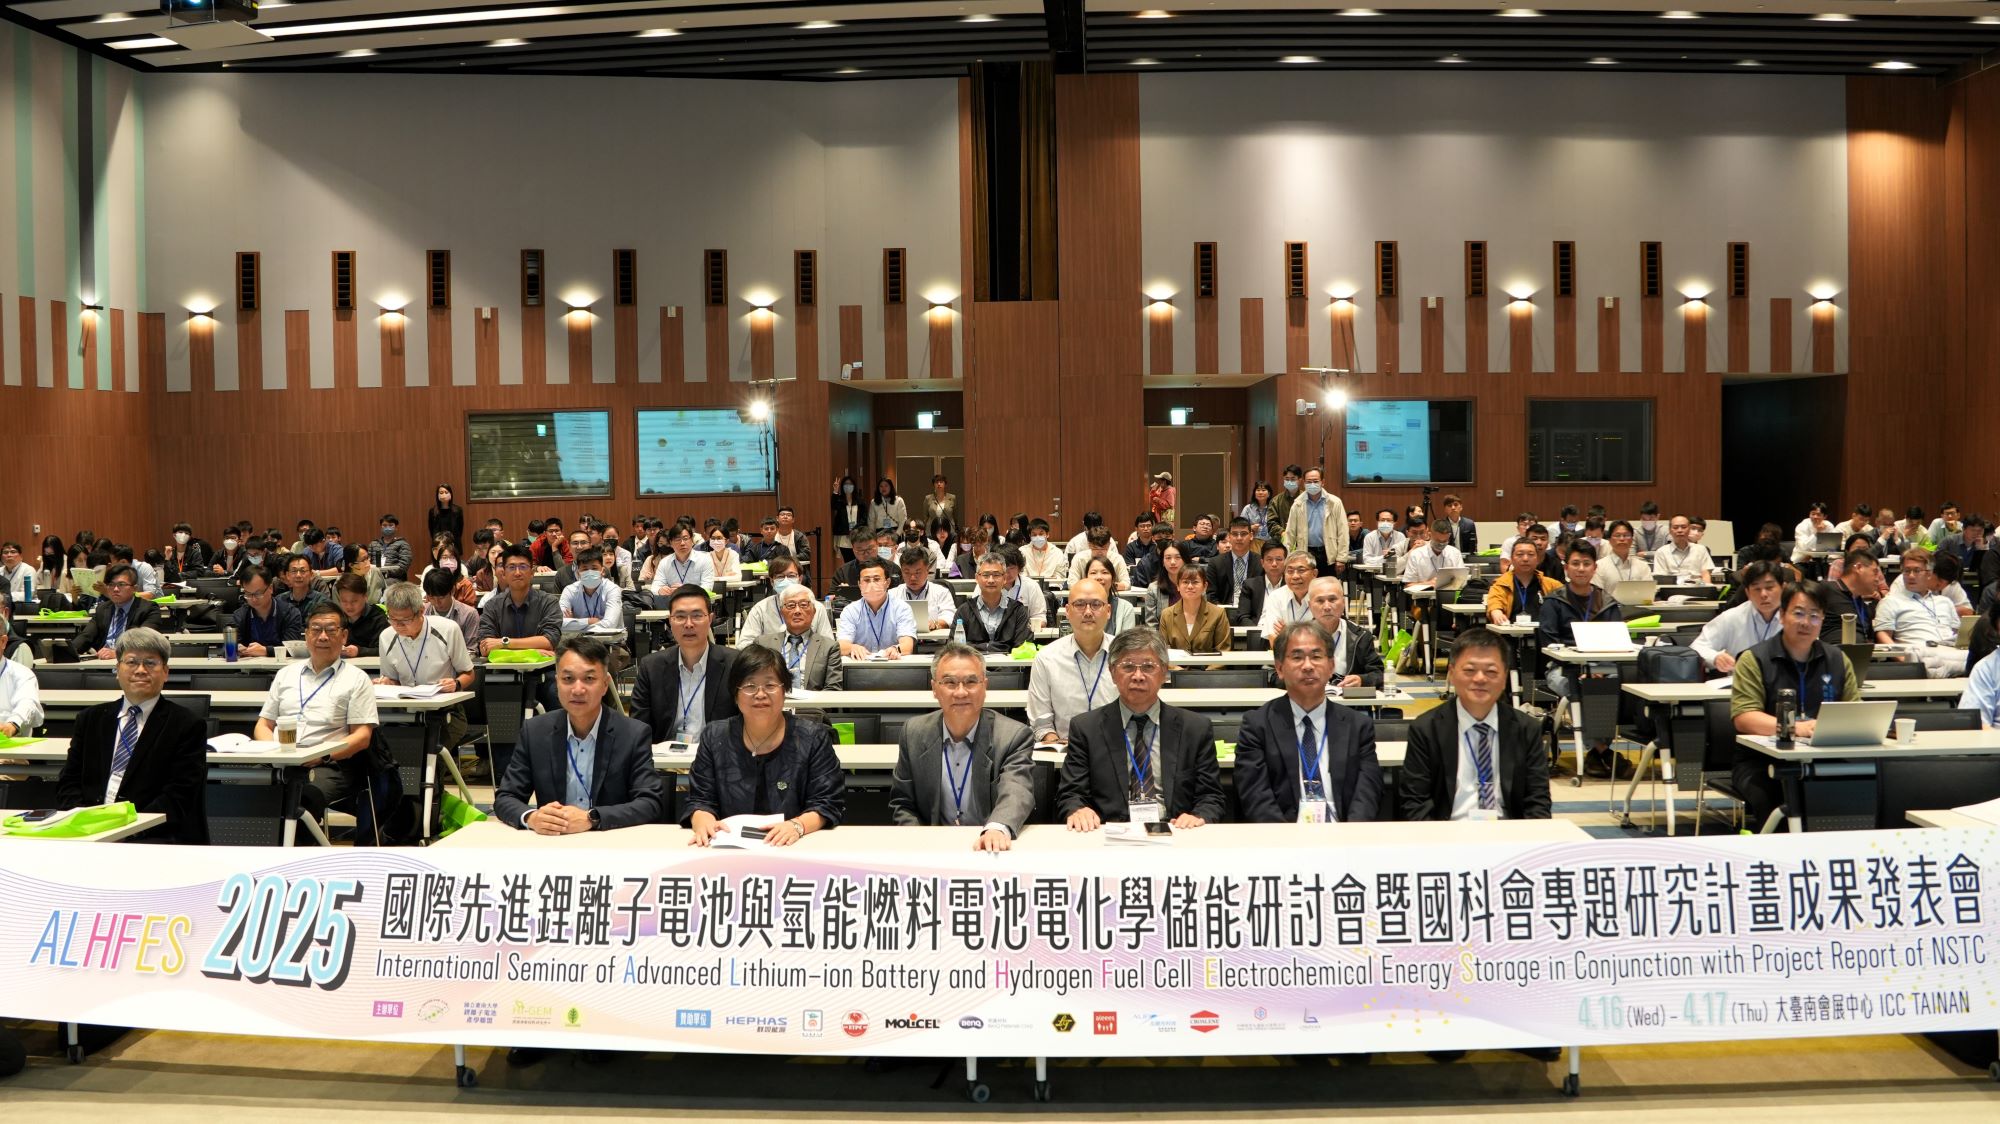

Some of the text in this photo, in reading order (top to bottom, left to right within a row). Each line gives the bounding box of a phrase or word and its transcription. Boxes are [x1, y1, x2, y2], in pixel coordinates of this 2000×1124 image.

[30, 909, 191, 975] ALHFES
[201, 871, 364, 992] 2025
[376, 949, 500, 982] International
[507, 953, 588, 984] Seminar
[596, 954, 617, 984] of
[623, 955, 722, 987] Advanced
[862, 959, 940, 995] Battery
[949, 960, 986, 989] and
[995, 960, 1093, 996] Hydrogen
[1102, 959, 1145, 988] Fuel
[1154, 958, 1192, 988] Cell
[1205, 955, 1372, 988] Electrochemical
[1382, 954, 1453, 990] Energy
[1459, 952, 1541, 988] Storage
[1548, 956, 1566, 981] in
[1575, 950, 1693, 985] Conjunction
[1701, 946, 1745, 975] with
[1752, 943, 1824, 977] Project
[1832, 940, 1897, 975] Report
[1905, 938, 1924, 967] of
[1932, 935, 1986, 966] NSTC
[725, 1016, 788, 1026] HEPHAS
[1578, 995, 1624, 1030] 4.16
[1627, 1004, 1665, 1028] (Wed)
[1683, 991, 1729, 1026] 4.17
[1731, 1001, 1769, 1025] (Thu)
[1776, 994, 1874, 1023] 大臺南會展中心
[1880, 990, 1970, 1017] ICC TAINAN
